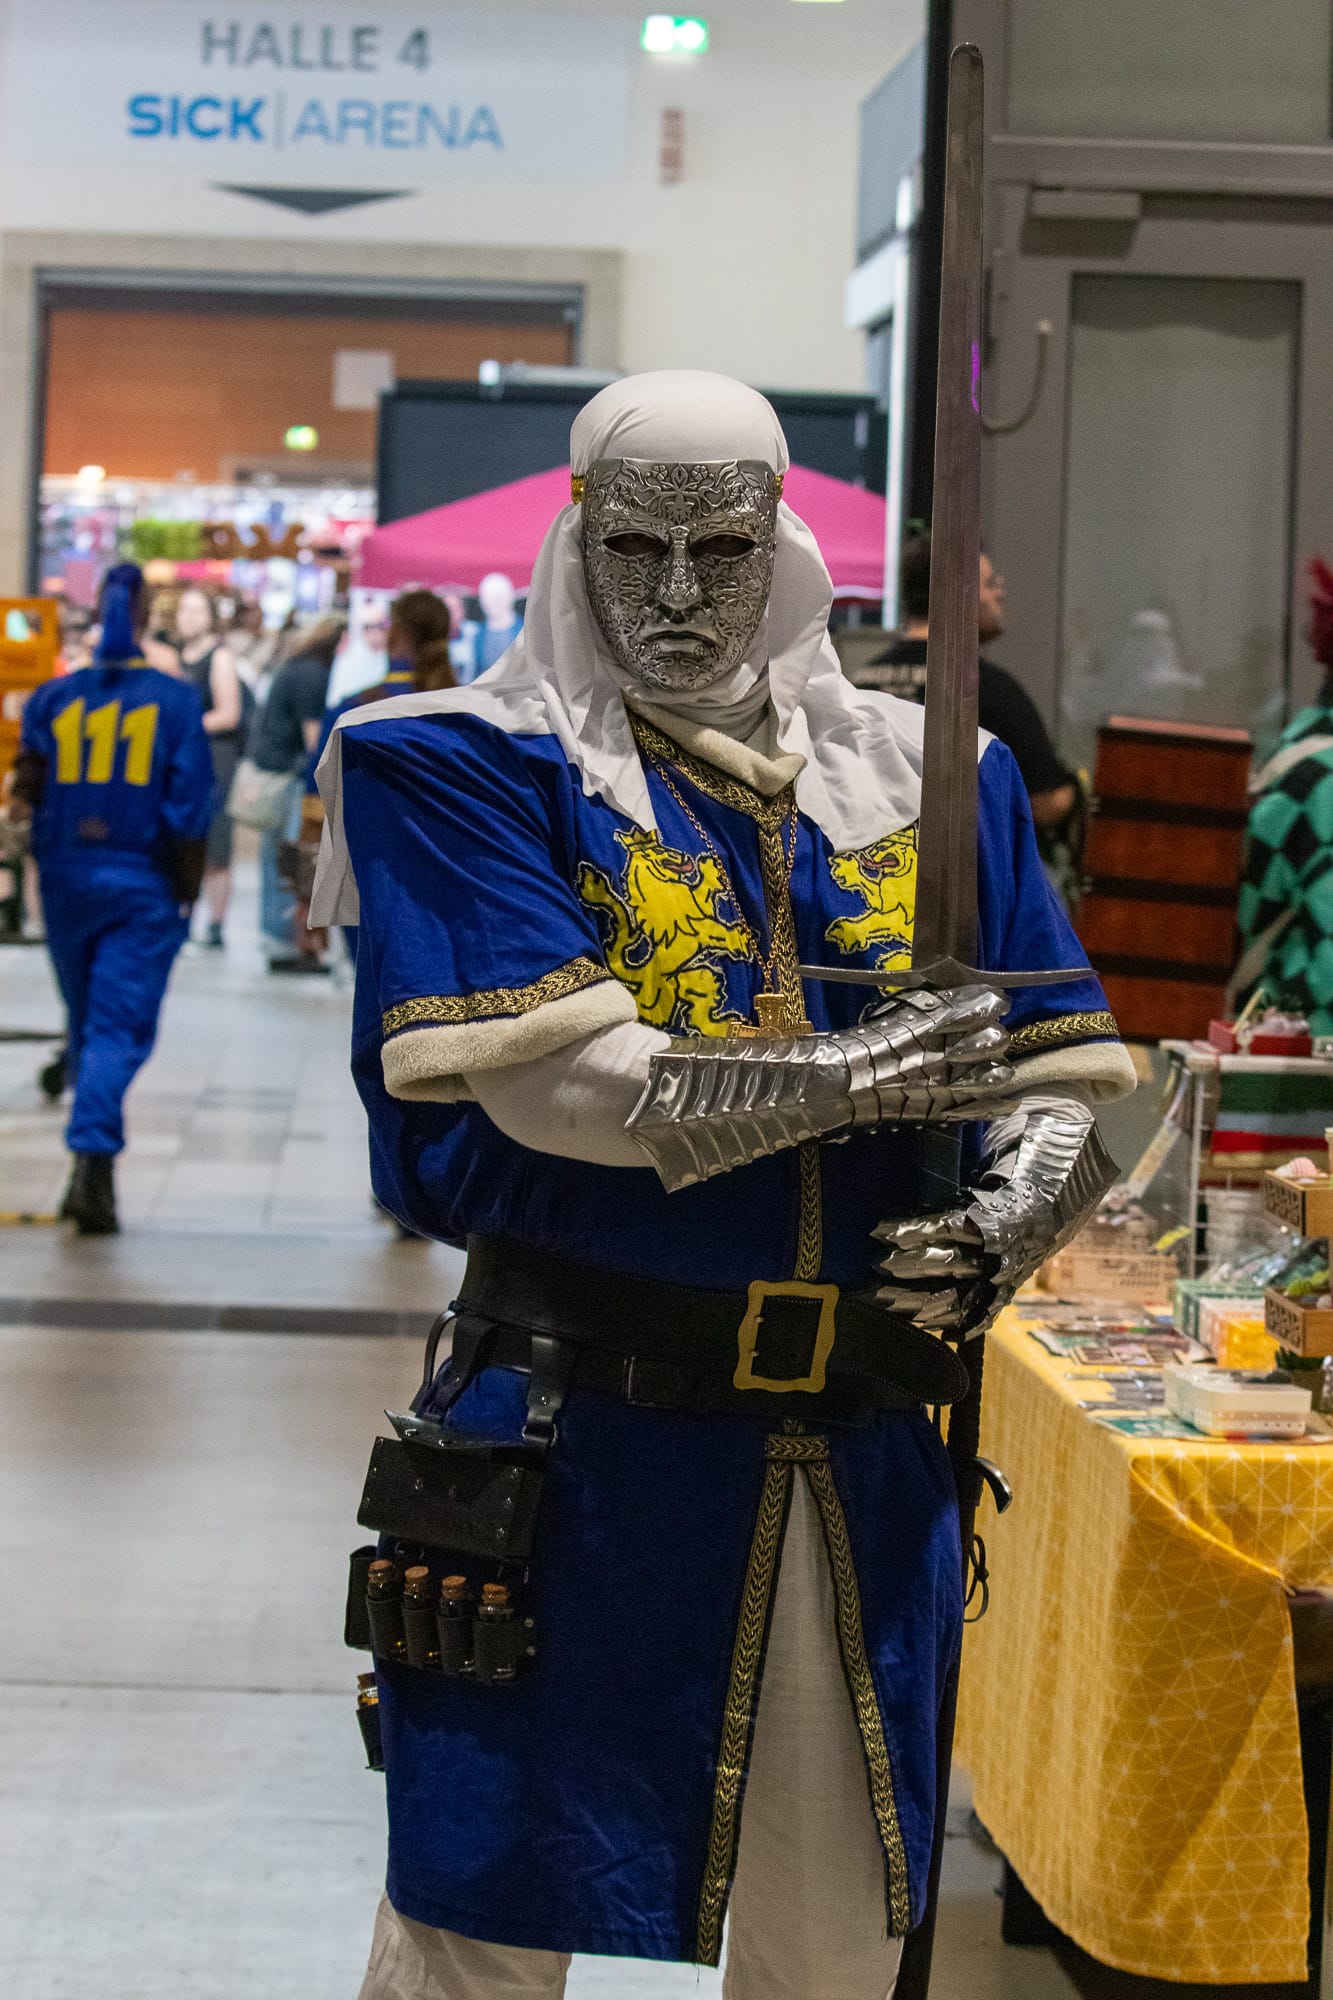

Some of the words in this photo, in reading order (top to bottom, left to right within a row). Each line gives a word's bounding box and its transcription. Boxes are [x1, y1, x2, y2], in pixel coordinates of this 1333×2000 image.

[201, 20, 381, 71] HALLE
[399, 27, 431, 71] 4
[126, 92, 267, 143] SICK
[293, 99, 504, 150] ARENA
[52, 698, 159, 786] 111
